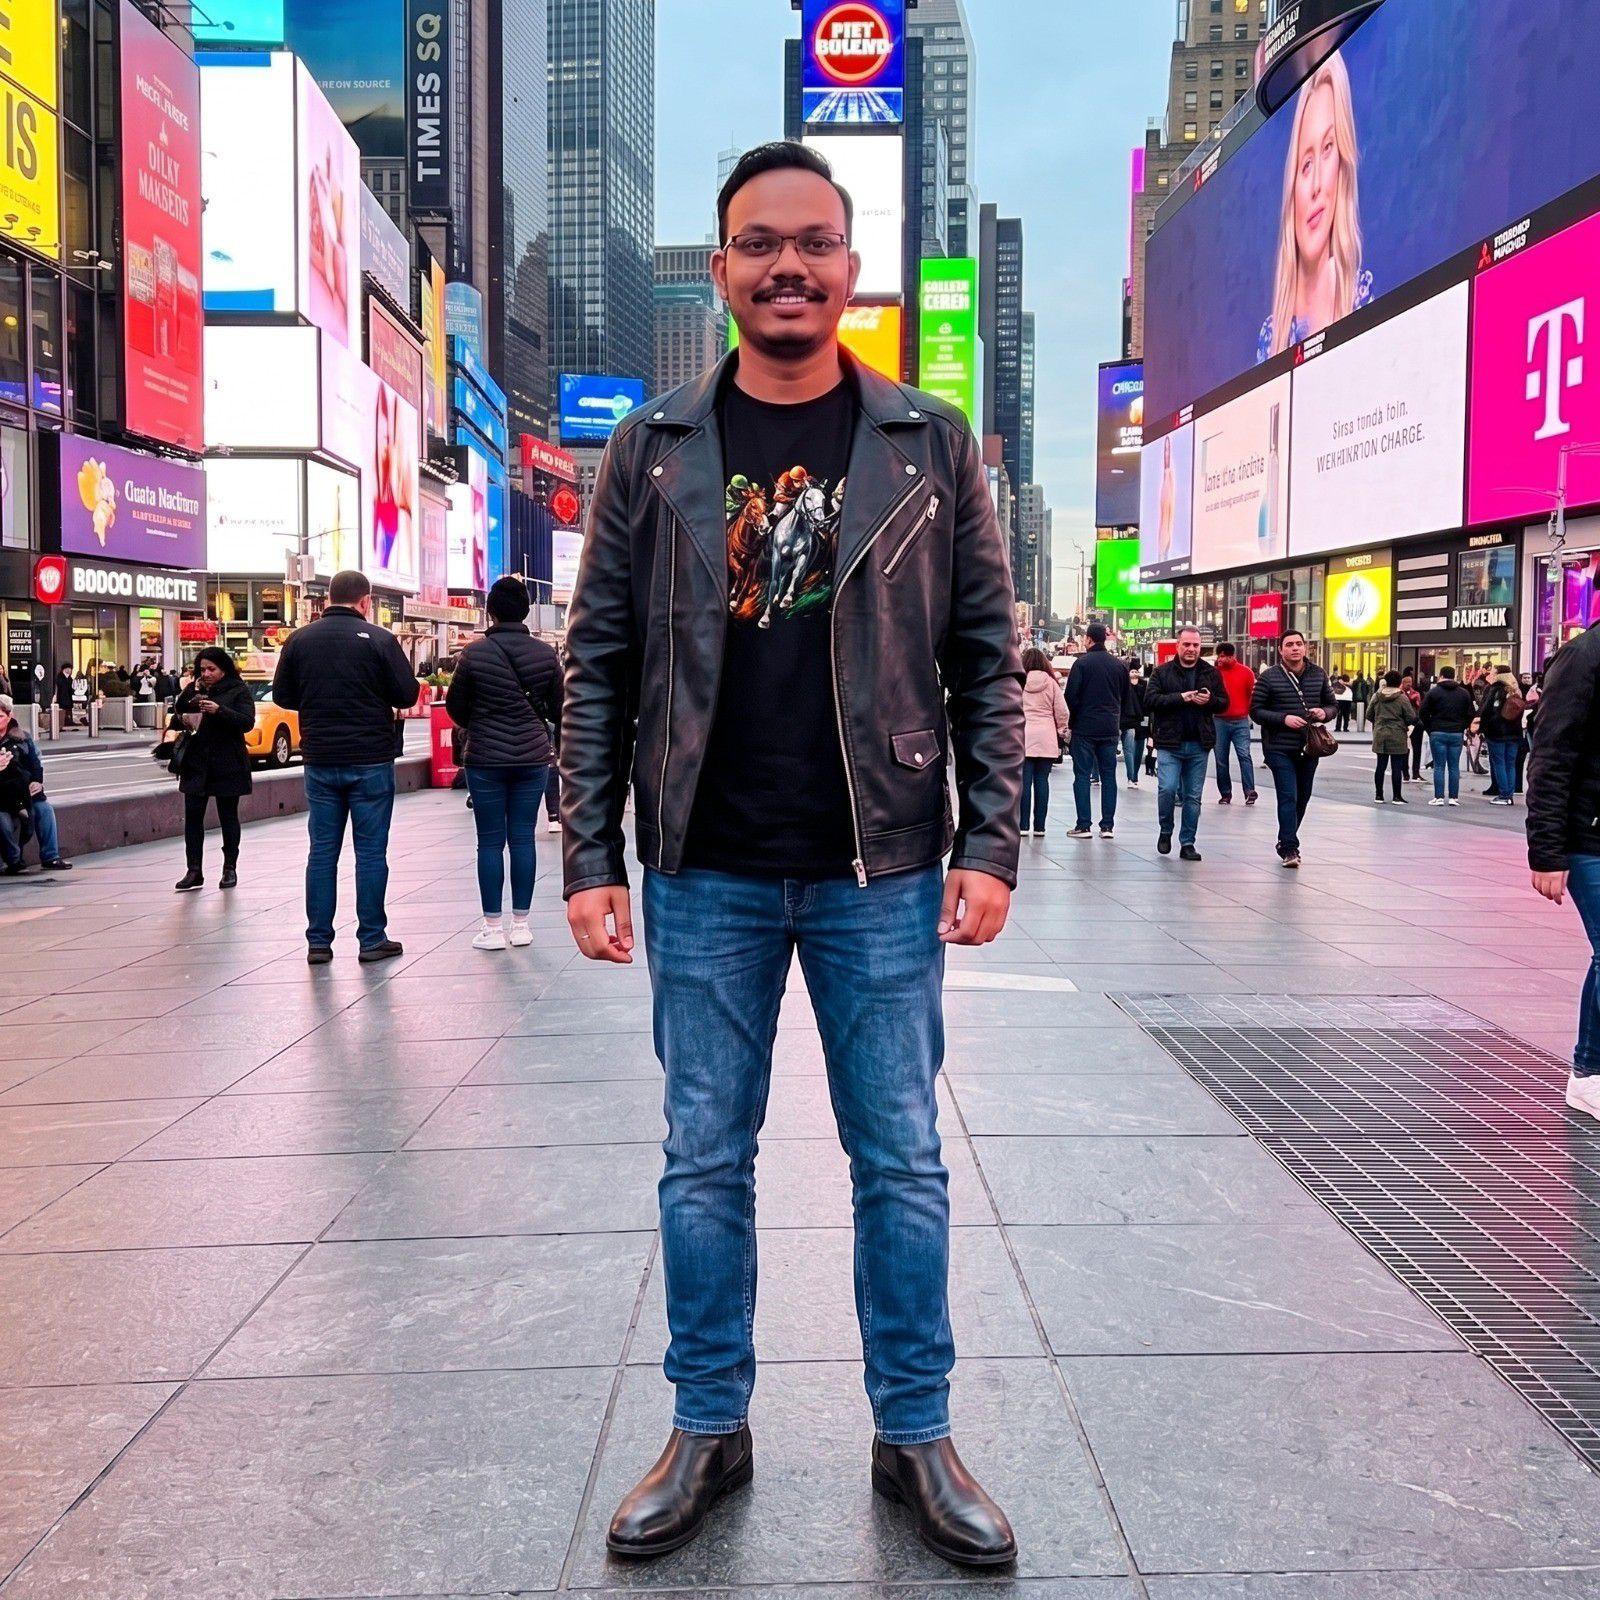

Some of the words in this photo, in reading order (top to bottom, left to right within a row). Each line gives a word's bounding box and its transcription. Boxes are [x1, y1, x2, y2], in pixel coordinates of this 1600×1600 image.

[416, 13, 441, 62] SQ
[831, 21, 875, 39] PIET
[353, 79, 391, 89] SOURCE
[6, 91, 37, 180] IS
[417, 72, 441, 182] TIMES
[1526, 297, 1585, 441] T
